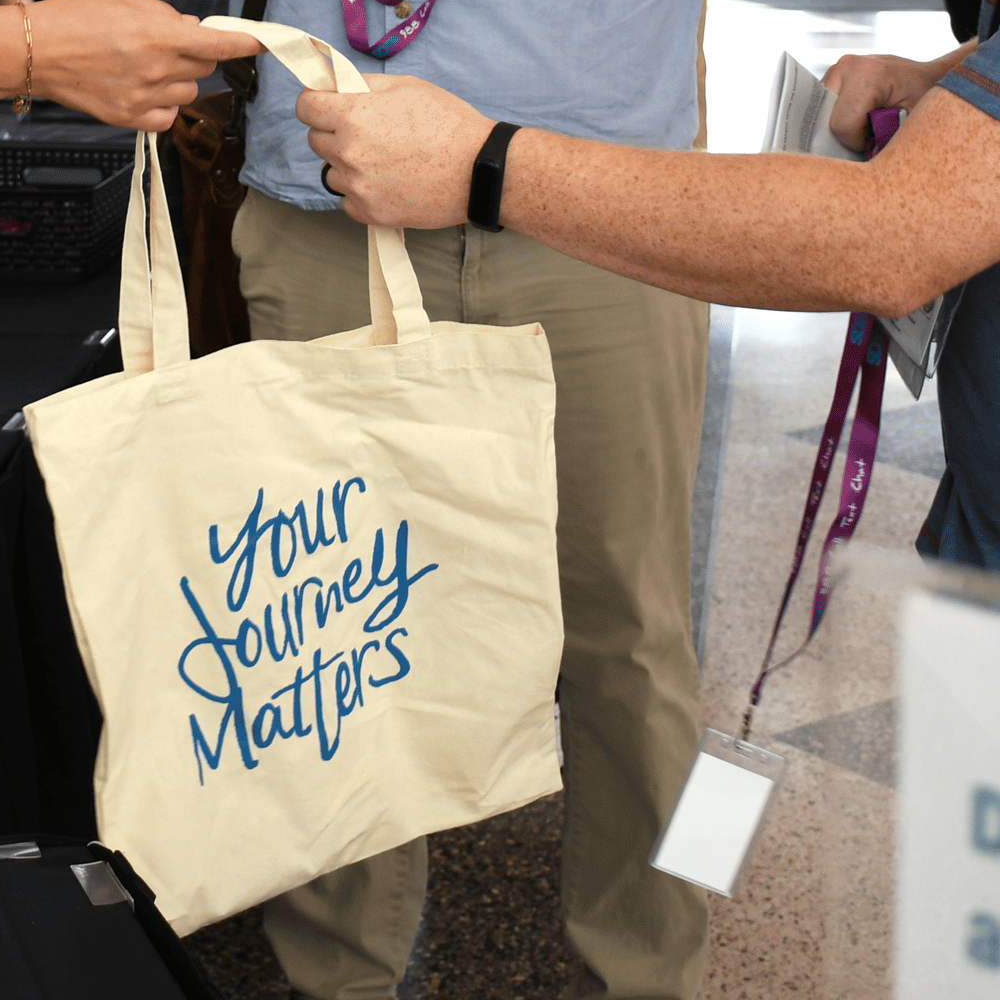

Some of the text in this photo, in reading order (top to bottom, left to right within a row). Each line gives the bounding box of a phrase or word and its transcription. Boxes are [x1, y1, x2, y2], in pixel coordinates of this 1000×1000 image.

[399, 20, 420, 38] 988
[208, 476, 366, 612] Your
[840, 458, 867, 528] Text Chat
[177, 519, 439, 704] Journey
[189, 627, 411, 786] Matters
